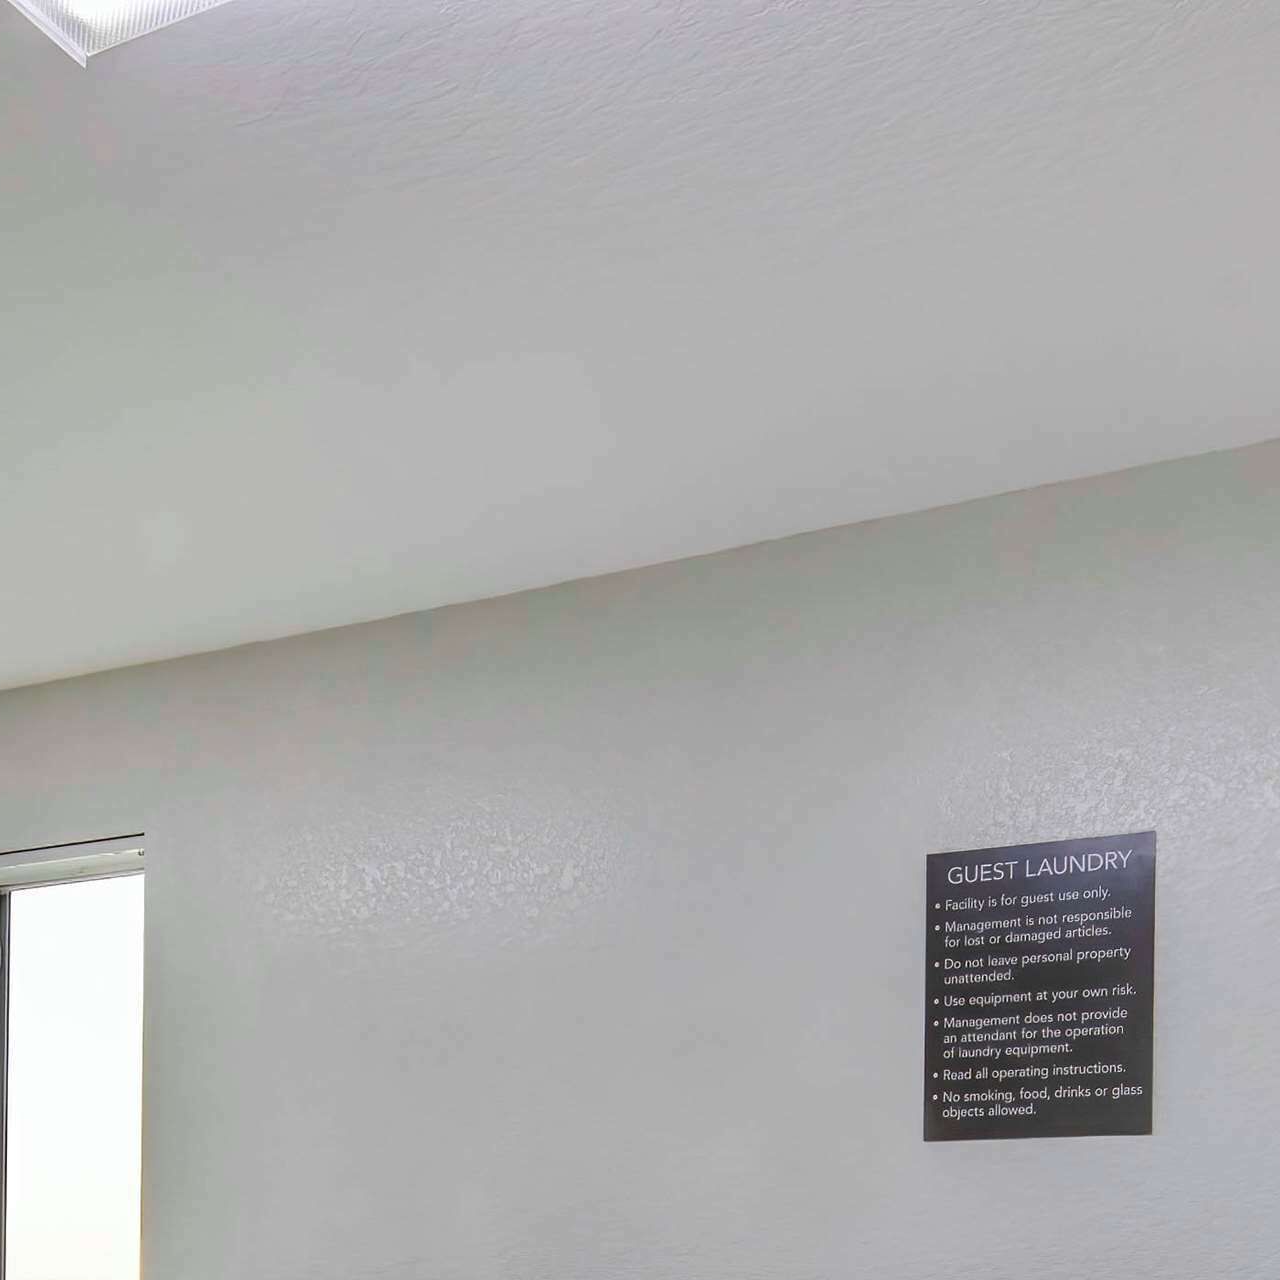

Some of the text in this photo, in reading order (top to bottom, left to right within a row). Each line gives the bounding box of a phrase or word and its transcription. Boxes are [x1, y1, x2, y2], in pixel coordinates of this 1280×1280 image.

[948, 850, 1133, 884] GUEST LAUNDRY
[945, 885, 1111, 911] Facility is for guest use only.
[945, 907, 1132, 934] Management is not responsible
[945, 925, 1112, 948] for lost or damaged articles.
[944, 947, 1131, 969] Do not leave personal property
[944, 970, 1014, 984] unattended.
[944, 983, 1136, 1007] Use equipment at your own risk.
[943, 1008, 1128, 1030] Management does not provide
[943, 1024, 1124, 1043] an attendant for the operation
[943, 1043, 1073, 1060] of laundry equipment.
[943, 1062, 1126, 1082] Read all operating instructions.
[943, 1084, 1143, 1103] No smoking, food, drinks or glass
[943, 1103, 1037, 1120] objects allowed.
